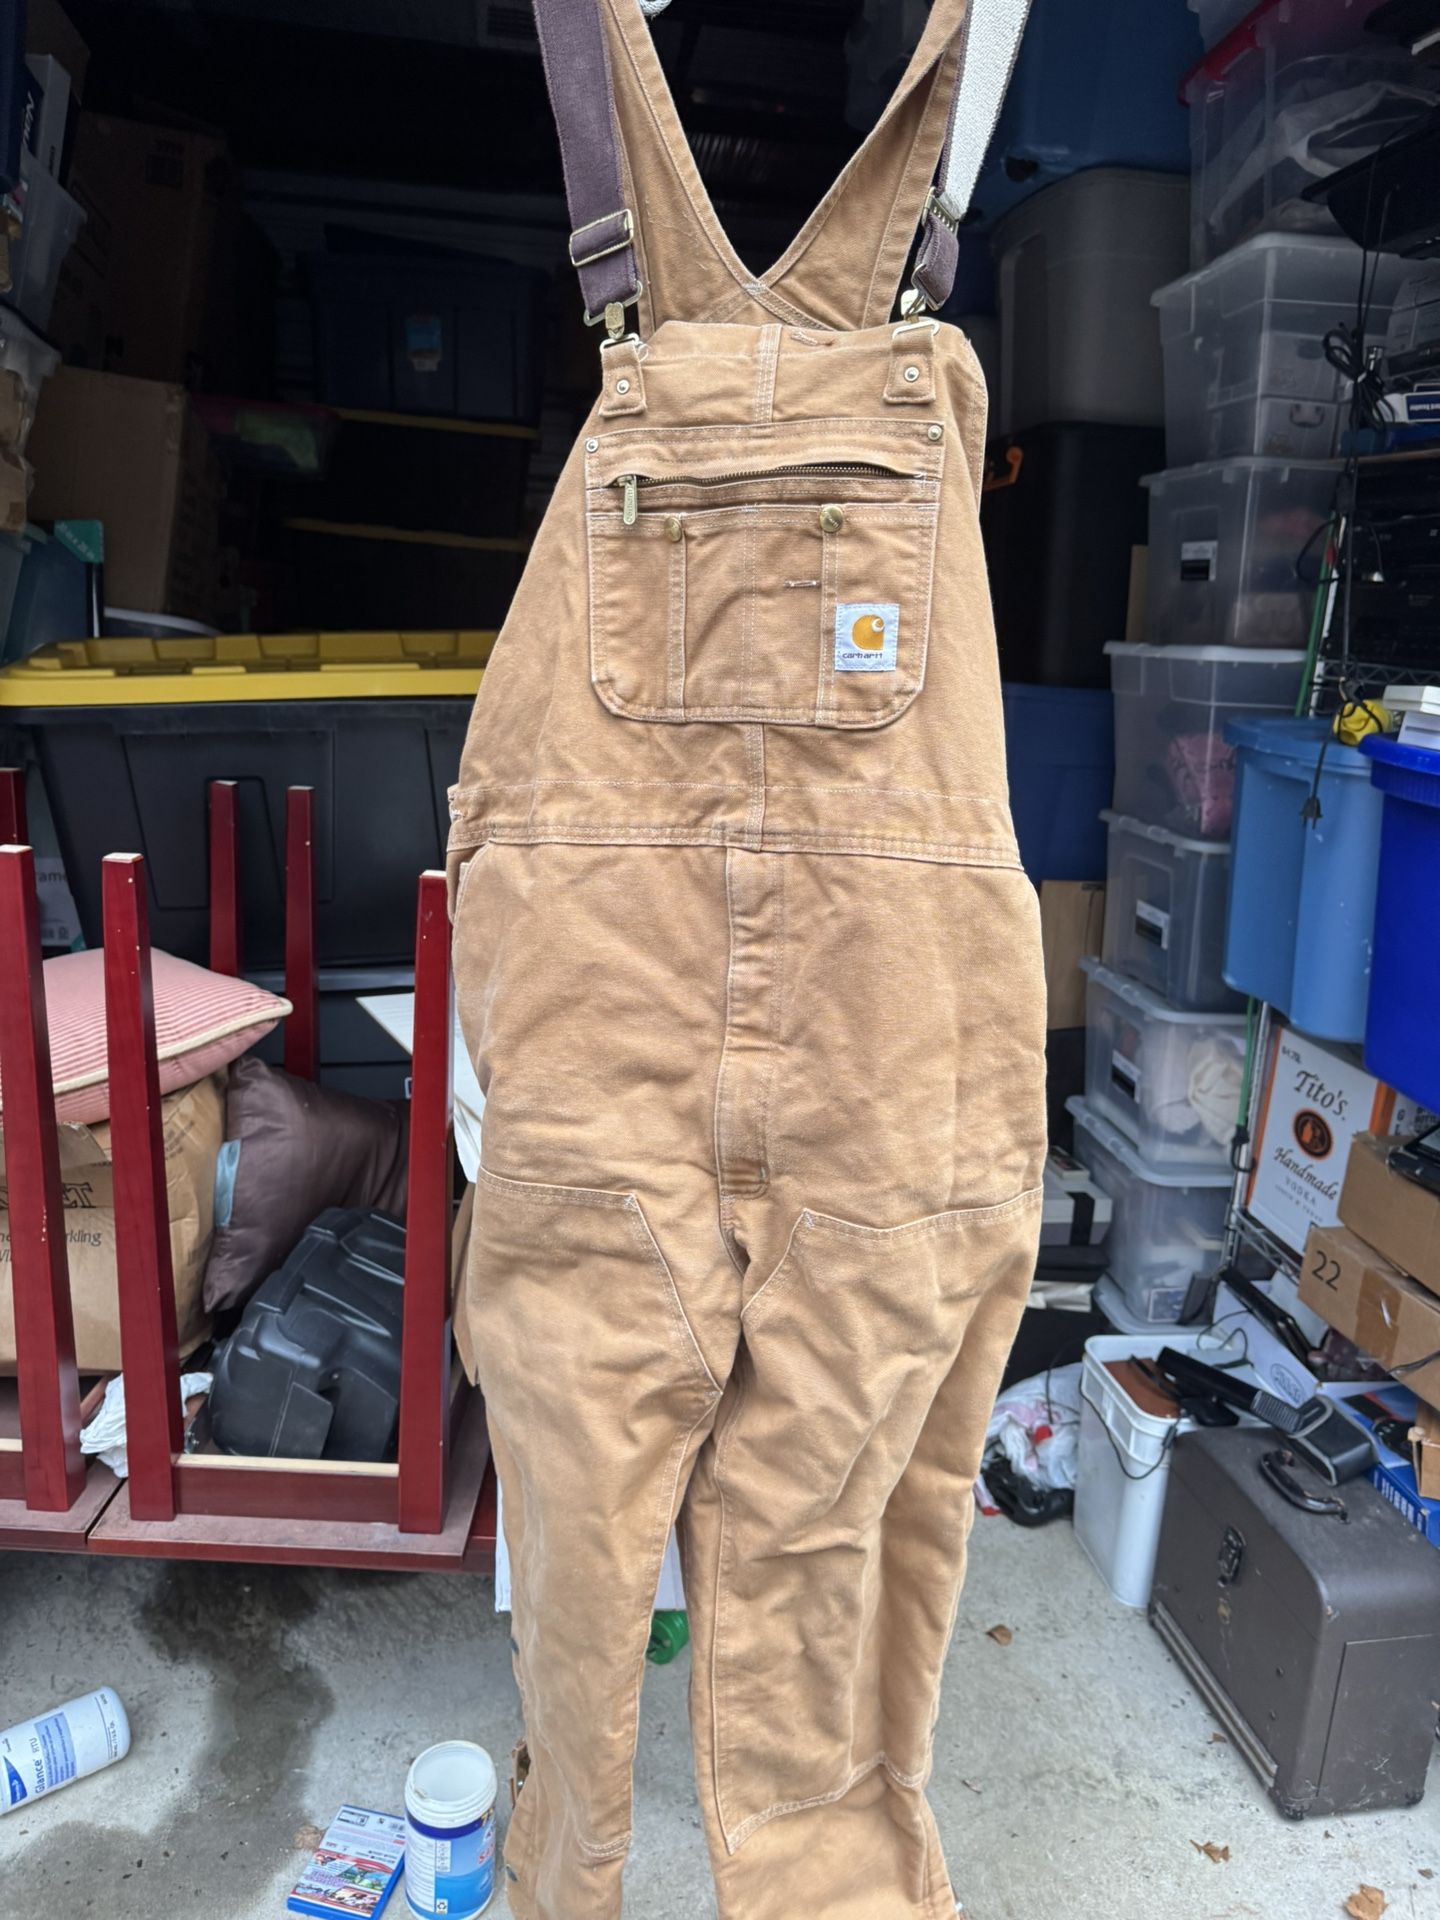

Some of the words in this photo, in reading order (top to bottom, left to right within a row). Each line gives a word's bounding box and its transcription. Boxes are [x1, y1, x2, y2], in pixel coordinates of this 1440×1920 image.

[842, 652, 883, 660] carhartt
[1294, 1070, 1349, 1116] Tito's
[1274, 1146, 1339, 1200] Handmade
[65, 1230, 102, 1247] rkling
[1312, 1250, 1341, 1291] 22
[34, 1758, 46, 1794] Glance
